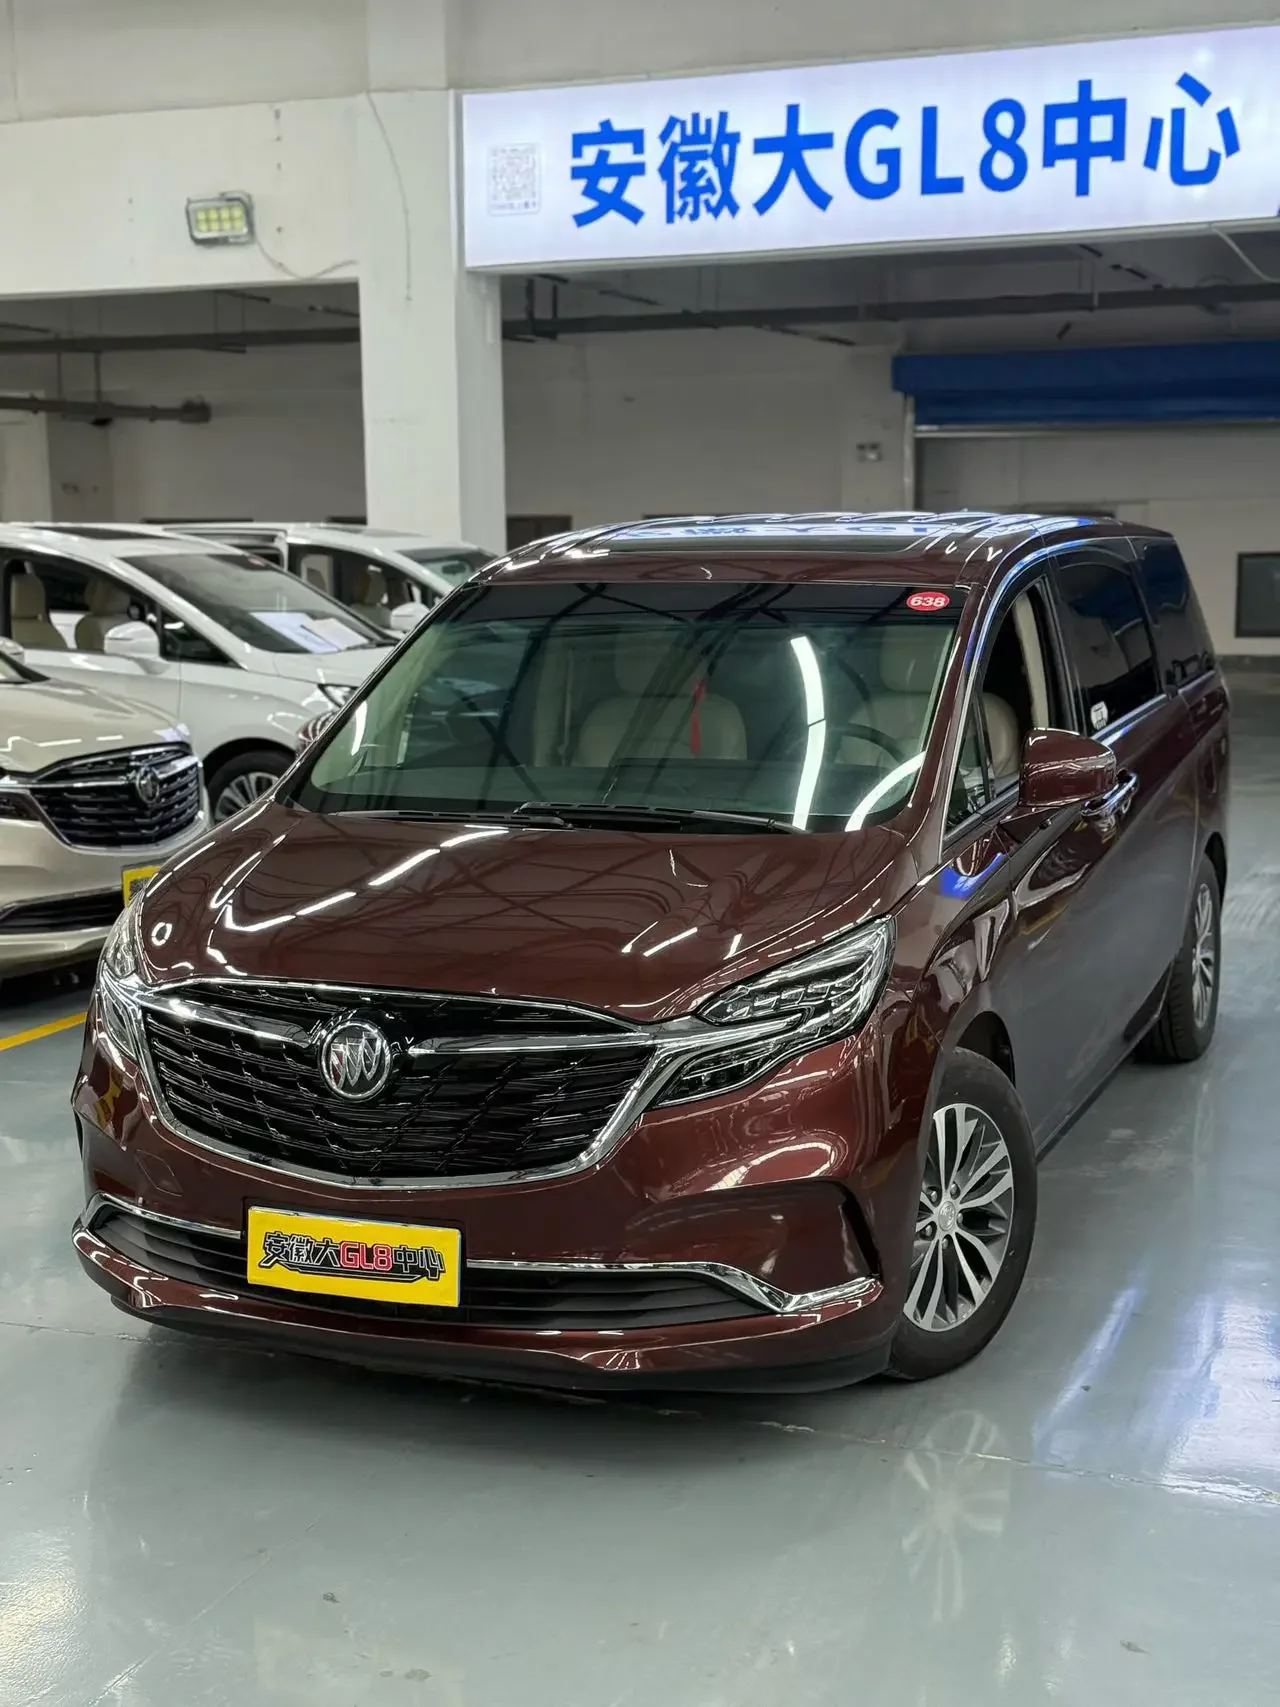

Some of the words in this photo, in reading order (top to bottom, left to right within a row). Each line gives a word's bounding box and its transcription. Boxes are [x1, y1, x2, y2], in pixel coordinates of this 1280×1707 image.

[571, 73, 1239, 227] 安徽大GL8中心
[910, 596, 946, 608] 638
[259, 1232, 446, 1280] 安徽大GL8中心
